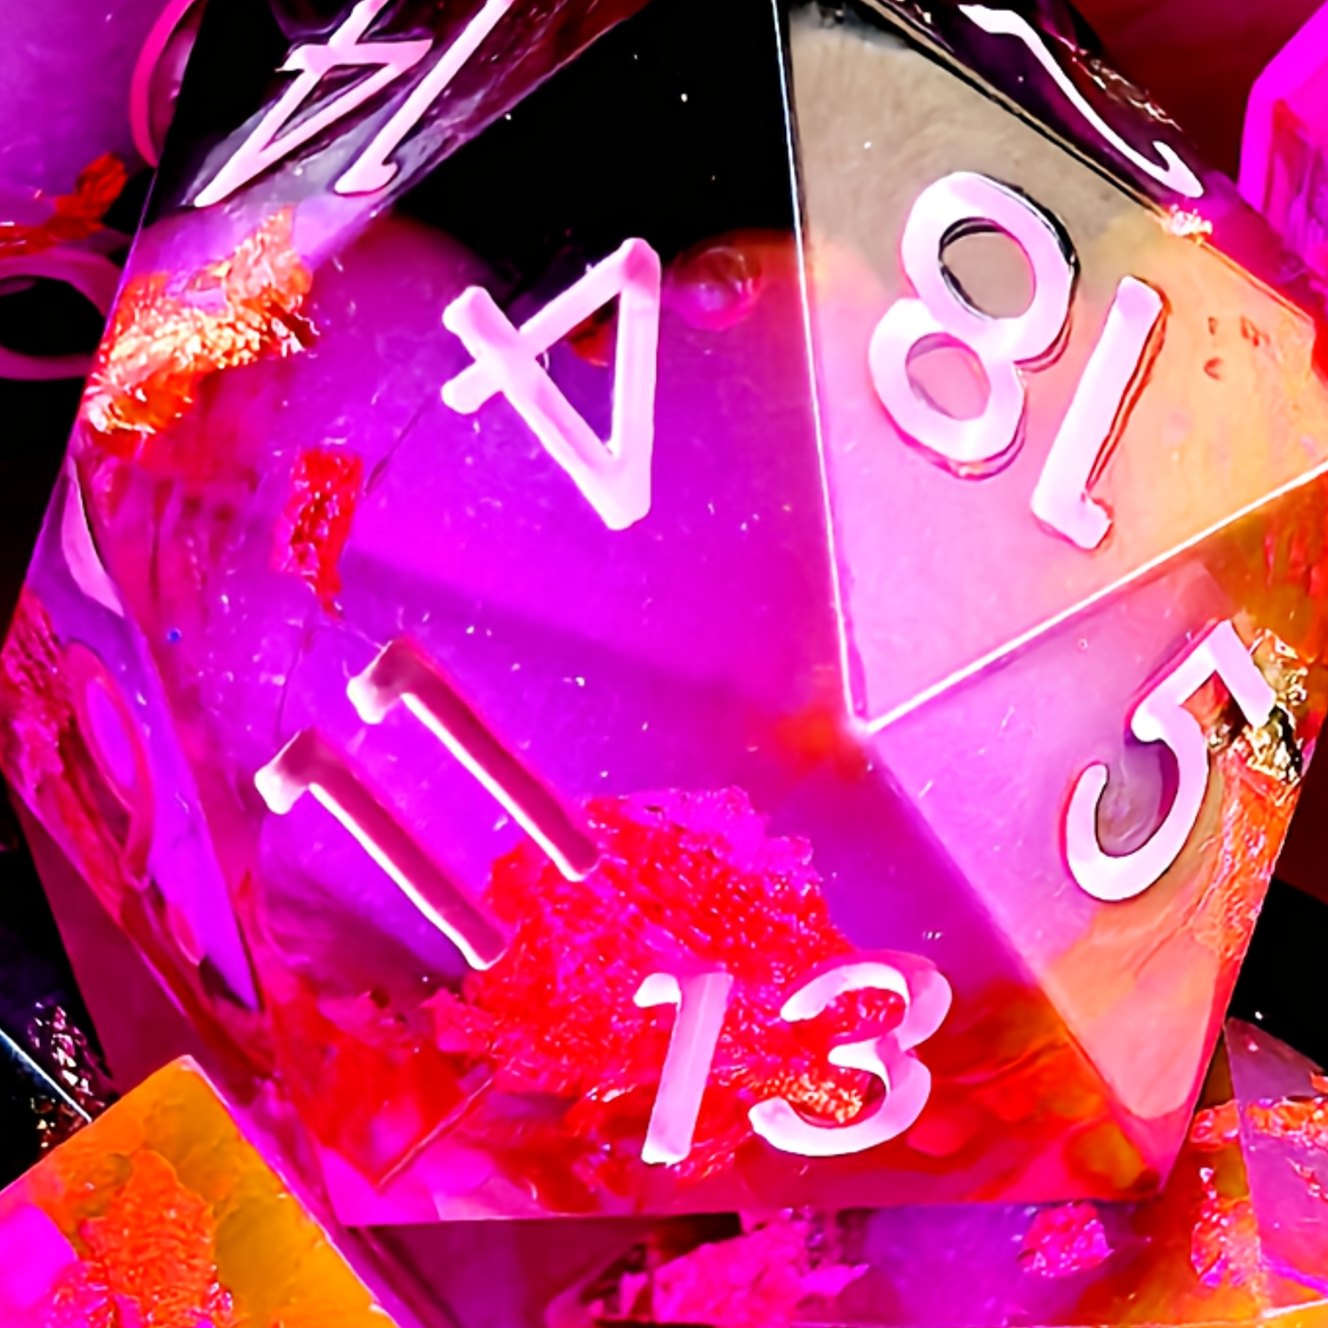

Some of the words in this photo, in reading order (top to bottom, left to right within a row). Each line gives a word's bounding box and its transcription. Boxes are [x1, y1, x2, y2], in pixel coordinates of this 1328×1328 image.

[442, 237, 661, 531] 4
[870, 170, 1171, 550] 18
[255, 634, 601, 971] 11
[1061, 619, 1277, 902] 5
[633, 950, 953, 1165] 13
